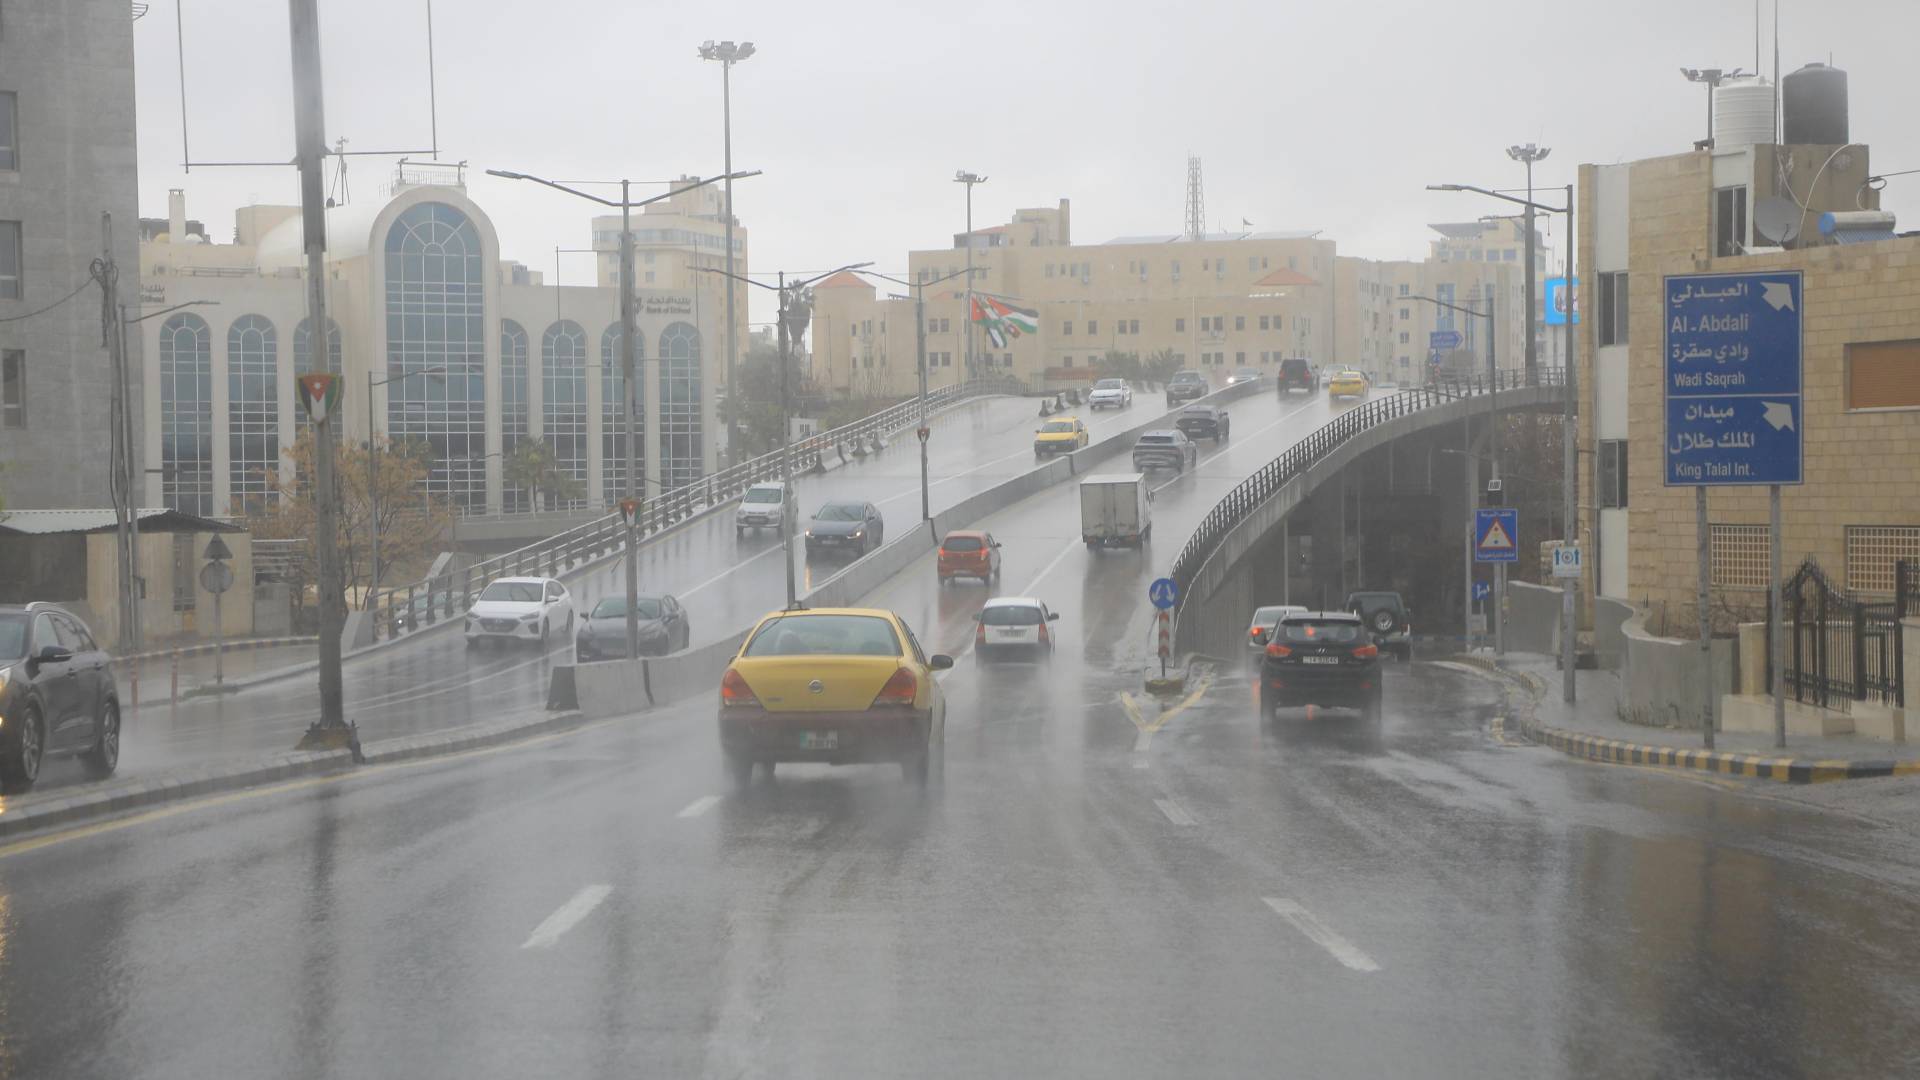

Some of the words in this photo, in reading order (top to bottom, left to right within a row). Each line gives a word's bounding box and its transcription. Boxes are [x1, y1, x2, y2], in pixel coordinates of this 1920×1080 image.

[1671, 282, 1748, 308] العبدلي
[1699, 313, 1749, 332] Abdali
[1672, 342, 1712, 362] صقرة
[1714, 342, 1749, 364] وادي
[1674, 372, 1702, 387] Wadi
[1704, 371, 1746, 389] Saqrah
[1684, 404, 1735, 424] ميدان
[1669, 432, 1714, 454] طلال
[1716, 432, 1755, 448] الملك
[1675, 463, 1701, 479] King
[1704, 462, 1731, 477] Talal
